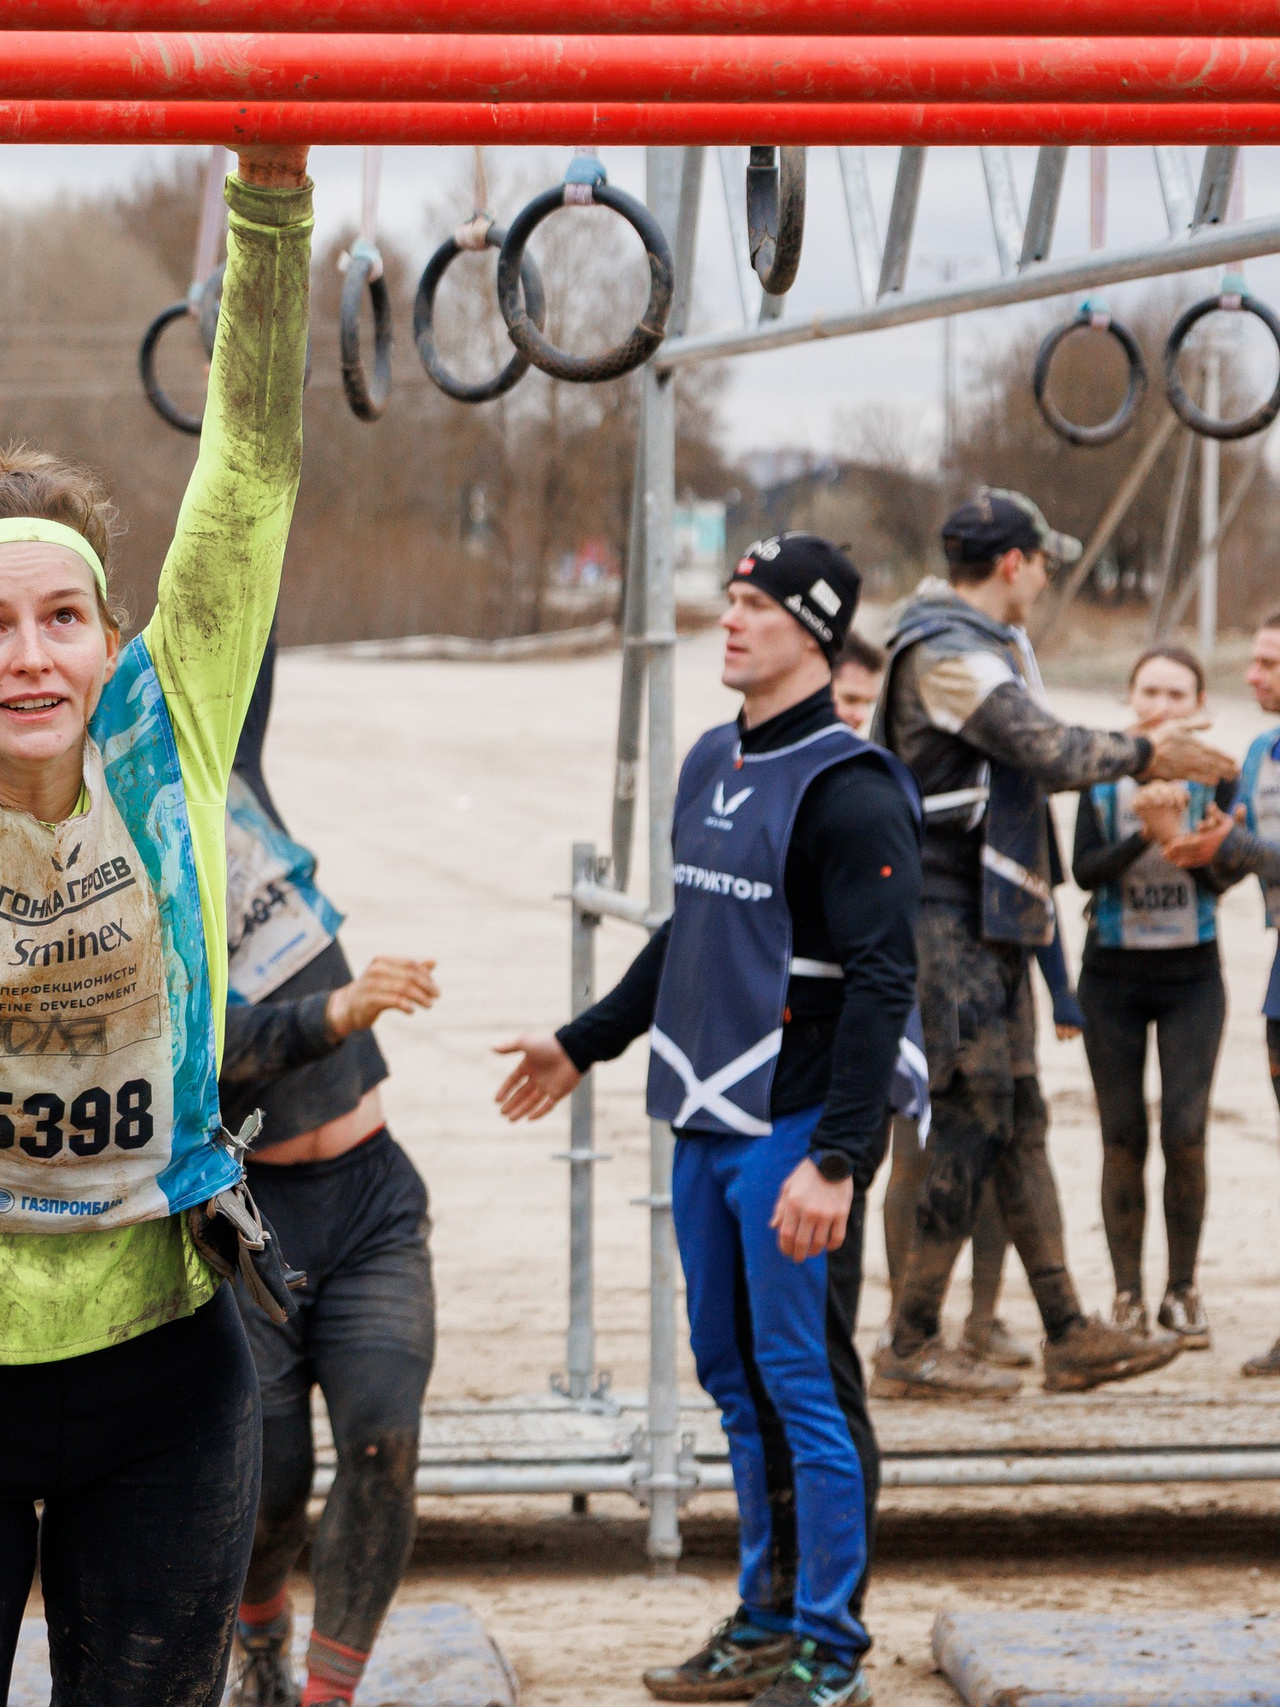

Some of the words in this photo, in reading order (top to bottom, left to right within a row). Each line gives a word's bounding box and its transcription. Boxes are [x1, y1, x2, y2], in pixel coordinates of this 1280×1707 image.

[66, 856, 133, 902] ГЕРОЕВ
[7, 918, 133, 967] Sminex
[0, 963, 138, 996] ПЕРФЕКЦИОНИСТЫ
[0, 1003, 32, 1012] FINE
[40, 982, 137, 1012] DEVELOPMENT
